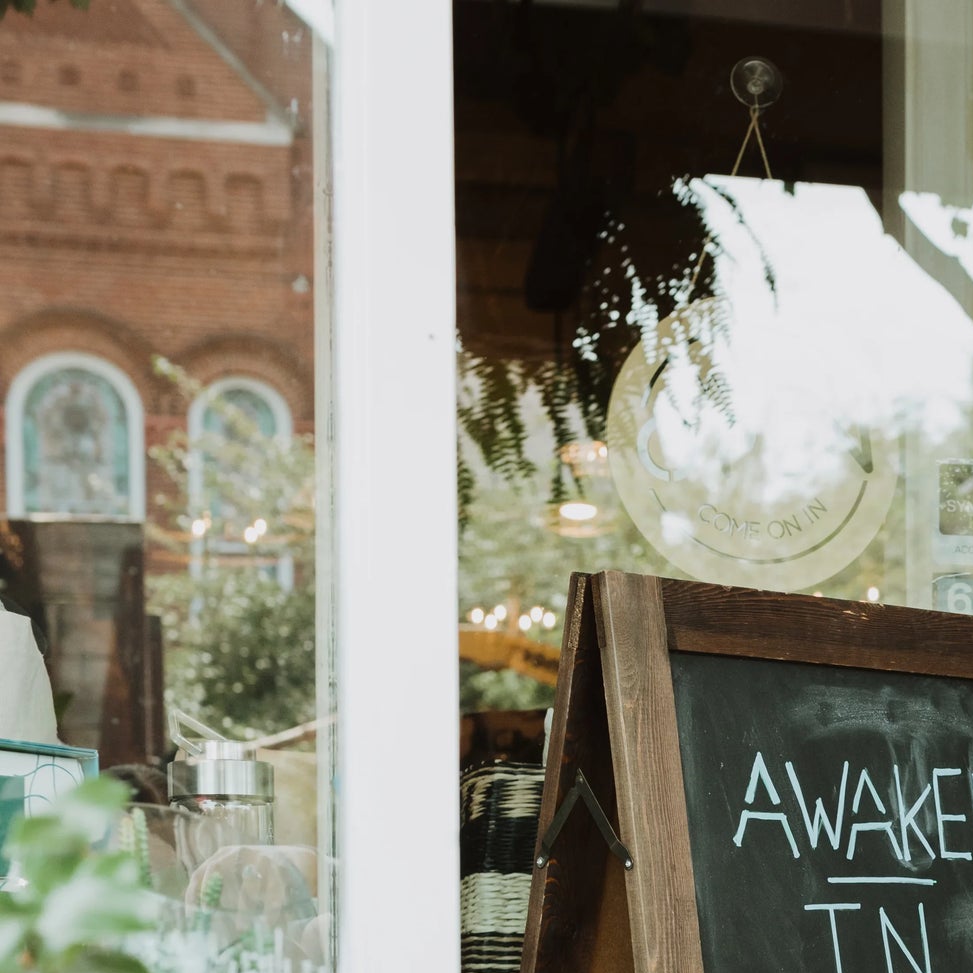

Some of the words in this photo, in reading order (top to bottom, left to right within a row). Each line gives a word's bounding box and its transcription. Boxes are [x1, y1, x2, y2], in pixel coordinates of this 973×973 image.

[698, 503, 760, 540] COME
[767, 514, 802, 539] ON
[802, 497, 828, 524] IN
[947, 582, 973, 612] 6
